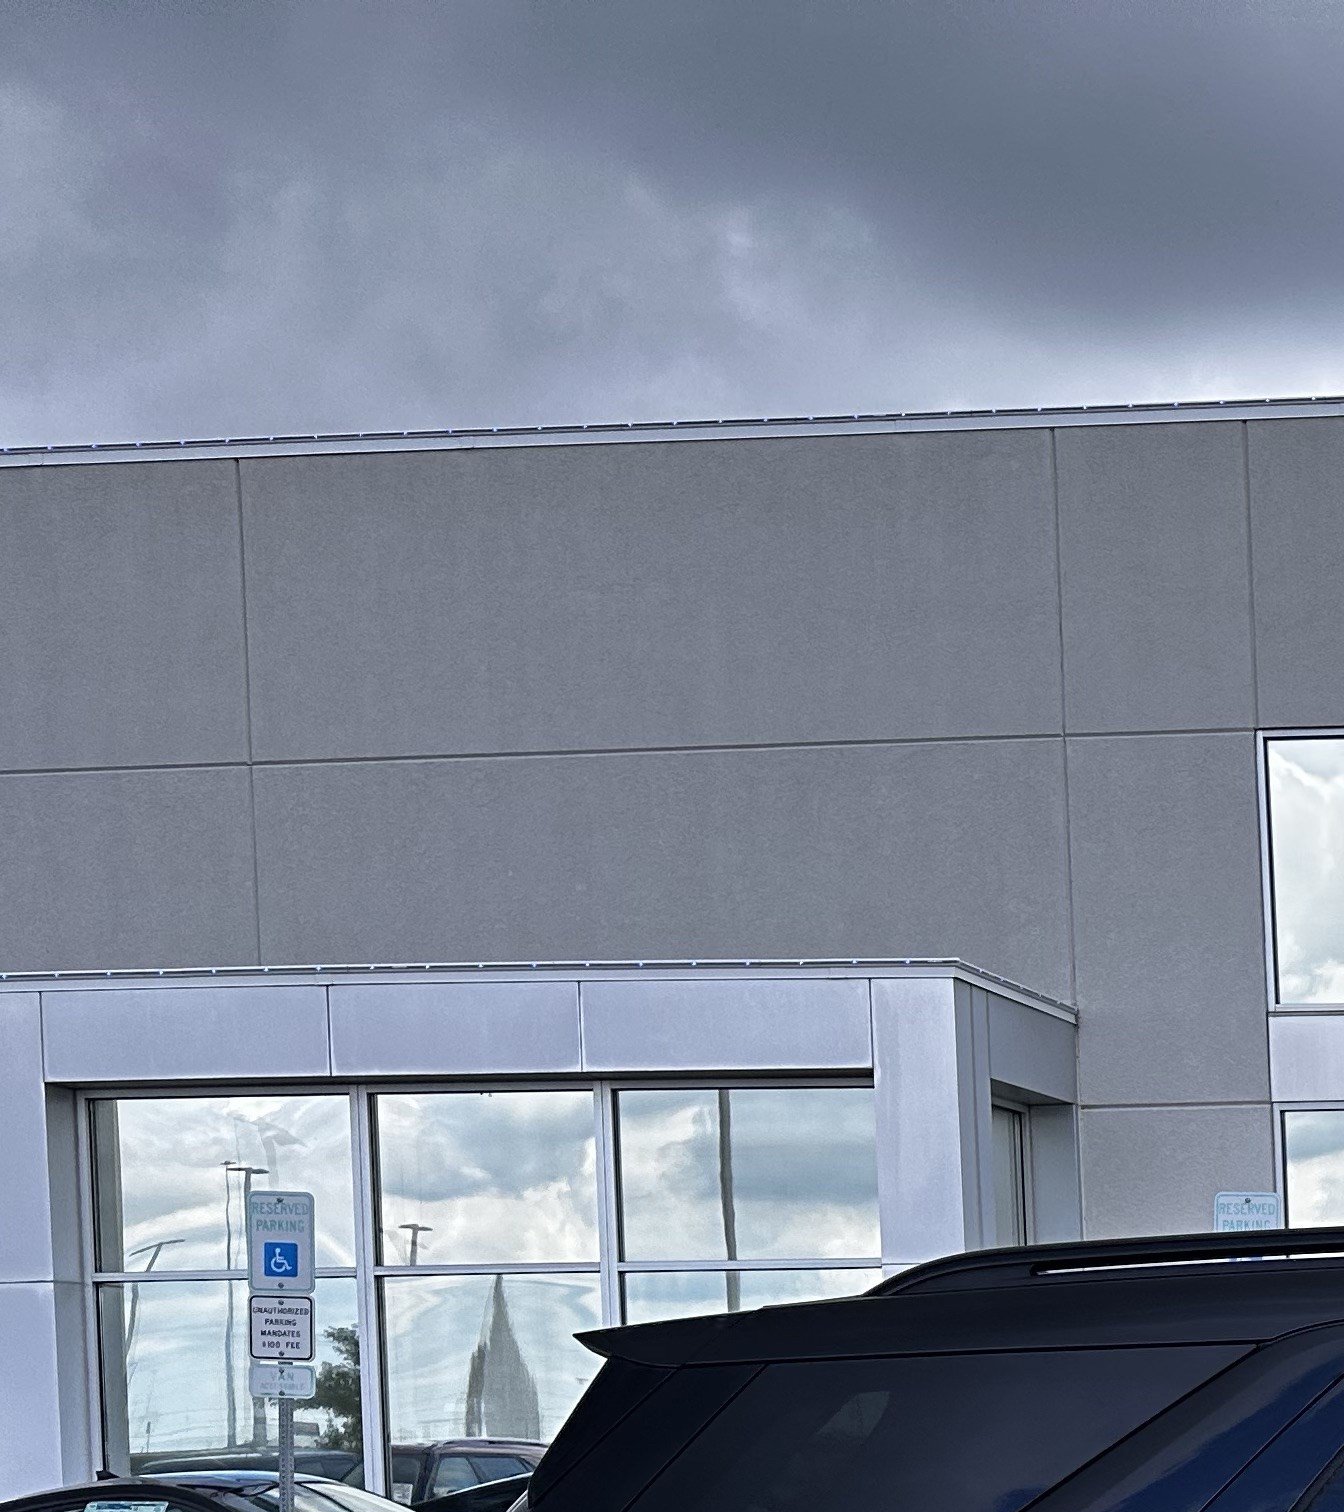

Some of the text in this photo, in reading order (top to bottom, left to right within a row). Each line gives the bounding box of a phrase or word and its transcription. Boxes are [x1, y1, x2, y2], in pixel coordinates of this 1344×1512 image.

[250, 1202, 309, 1216] RESERVED
[1218, 1203, 1276, 1216] RESERVED
[256, 1219, 304, 1232] PARKING
[252, 1307, 310, 1316] UNAUTHORIZED
